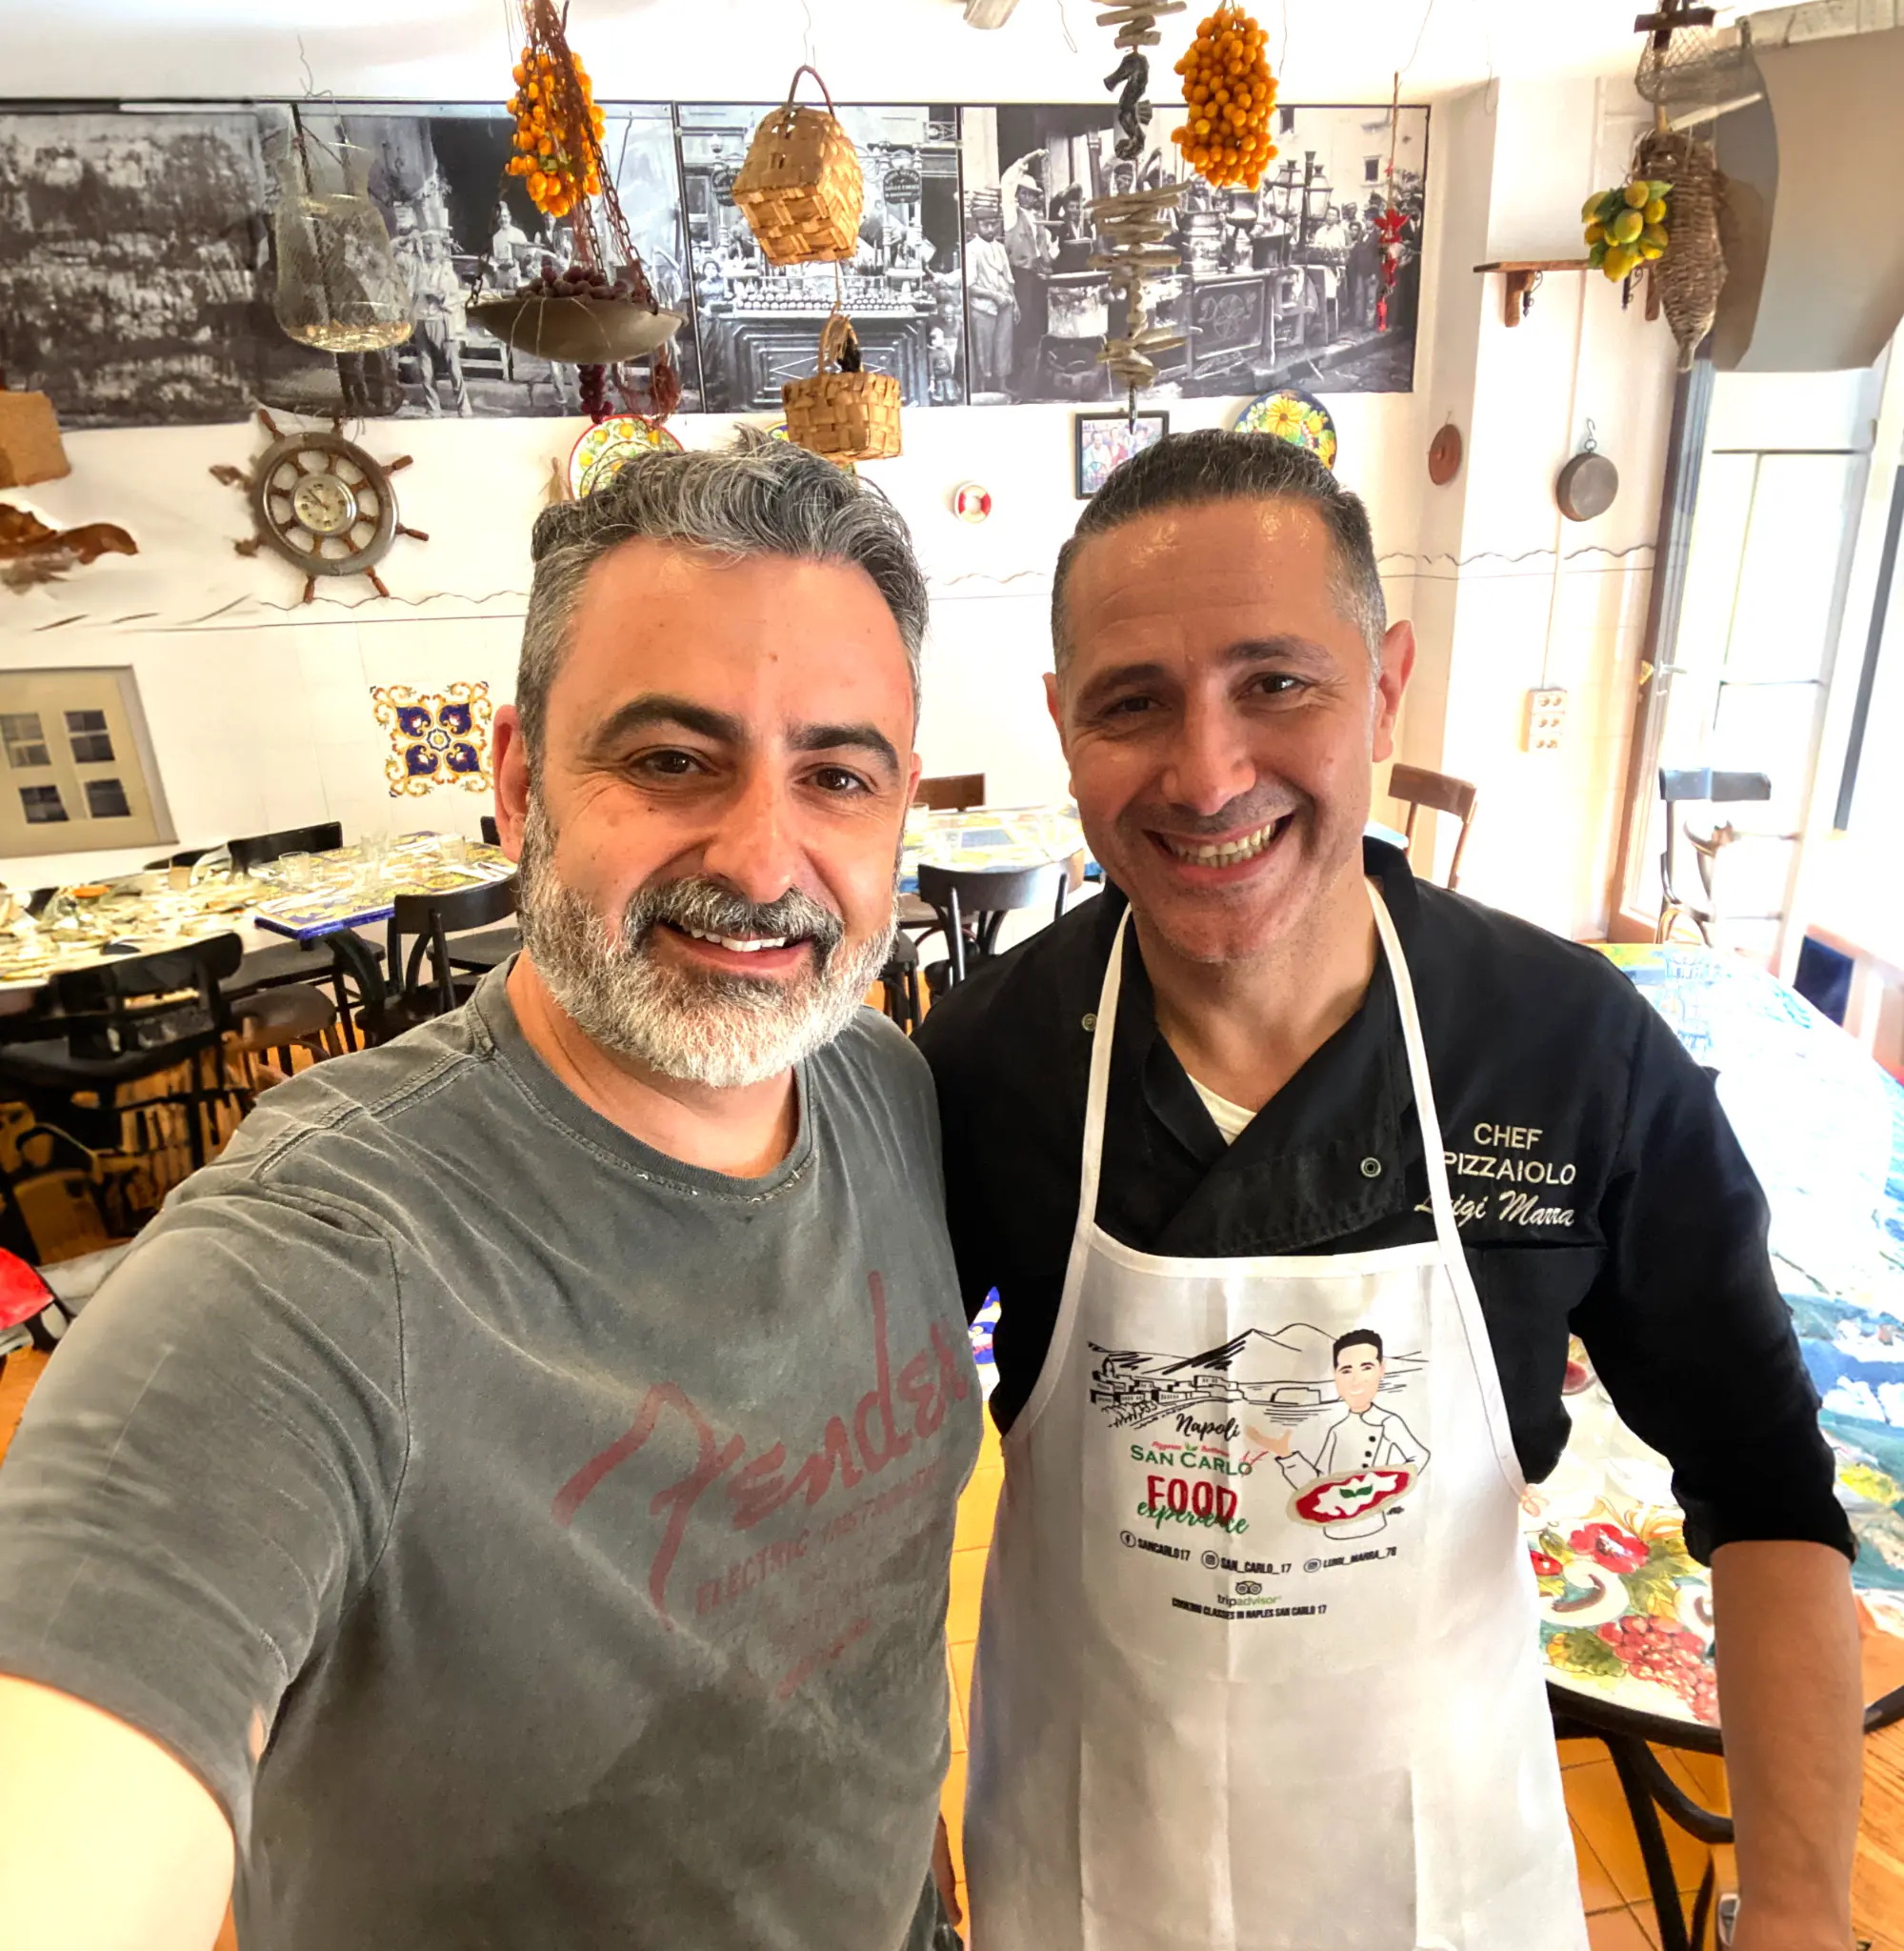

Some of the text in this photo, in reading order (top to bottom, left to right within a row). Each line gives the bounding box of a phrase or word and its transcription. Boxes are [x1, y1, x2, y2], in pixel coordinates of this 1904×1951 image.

[1473, 1123, 1543, 1150] CHEF
[1443, 1151, 1576, 1185] PIZZAIOLO
[1175, 1413, 1241, 1441] Napoli
[551, 1269, 969, 1632] Fender
[1131, 1444, 1174, 1466] SAN
[1180, 1452, 1253, 1476] CARLO
[1147, 1475, 1238, 1523] FOOD
[1246, 1609, 1273, 1619] NAPLES
[1275, 1607, 1291, 1617] SAN
[1292, 1605, 1315, 1617] CARLO
[1317, 1604, 1328, 1615] 17
